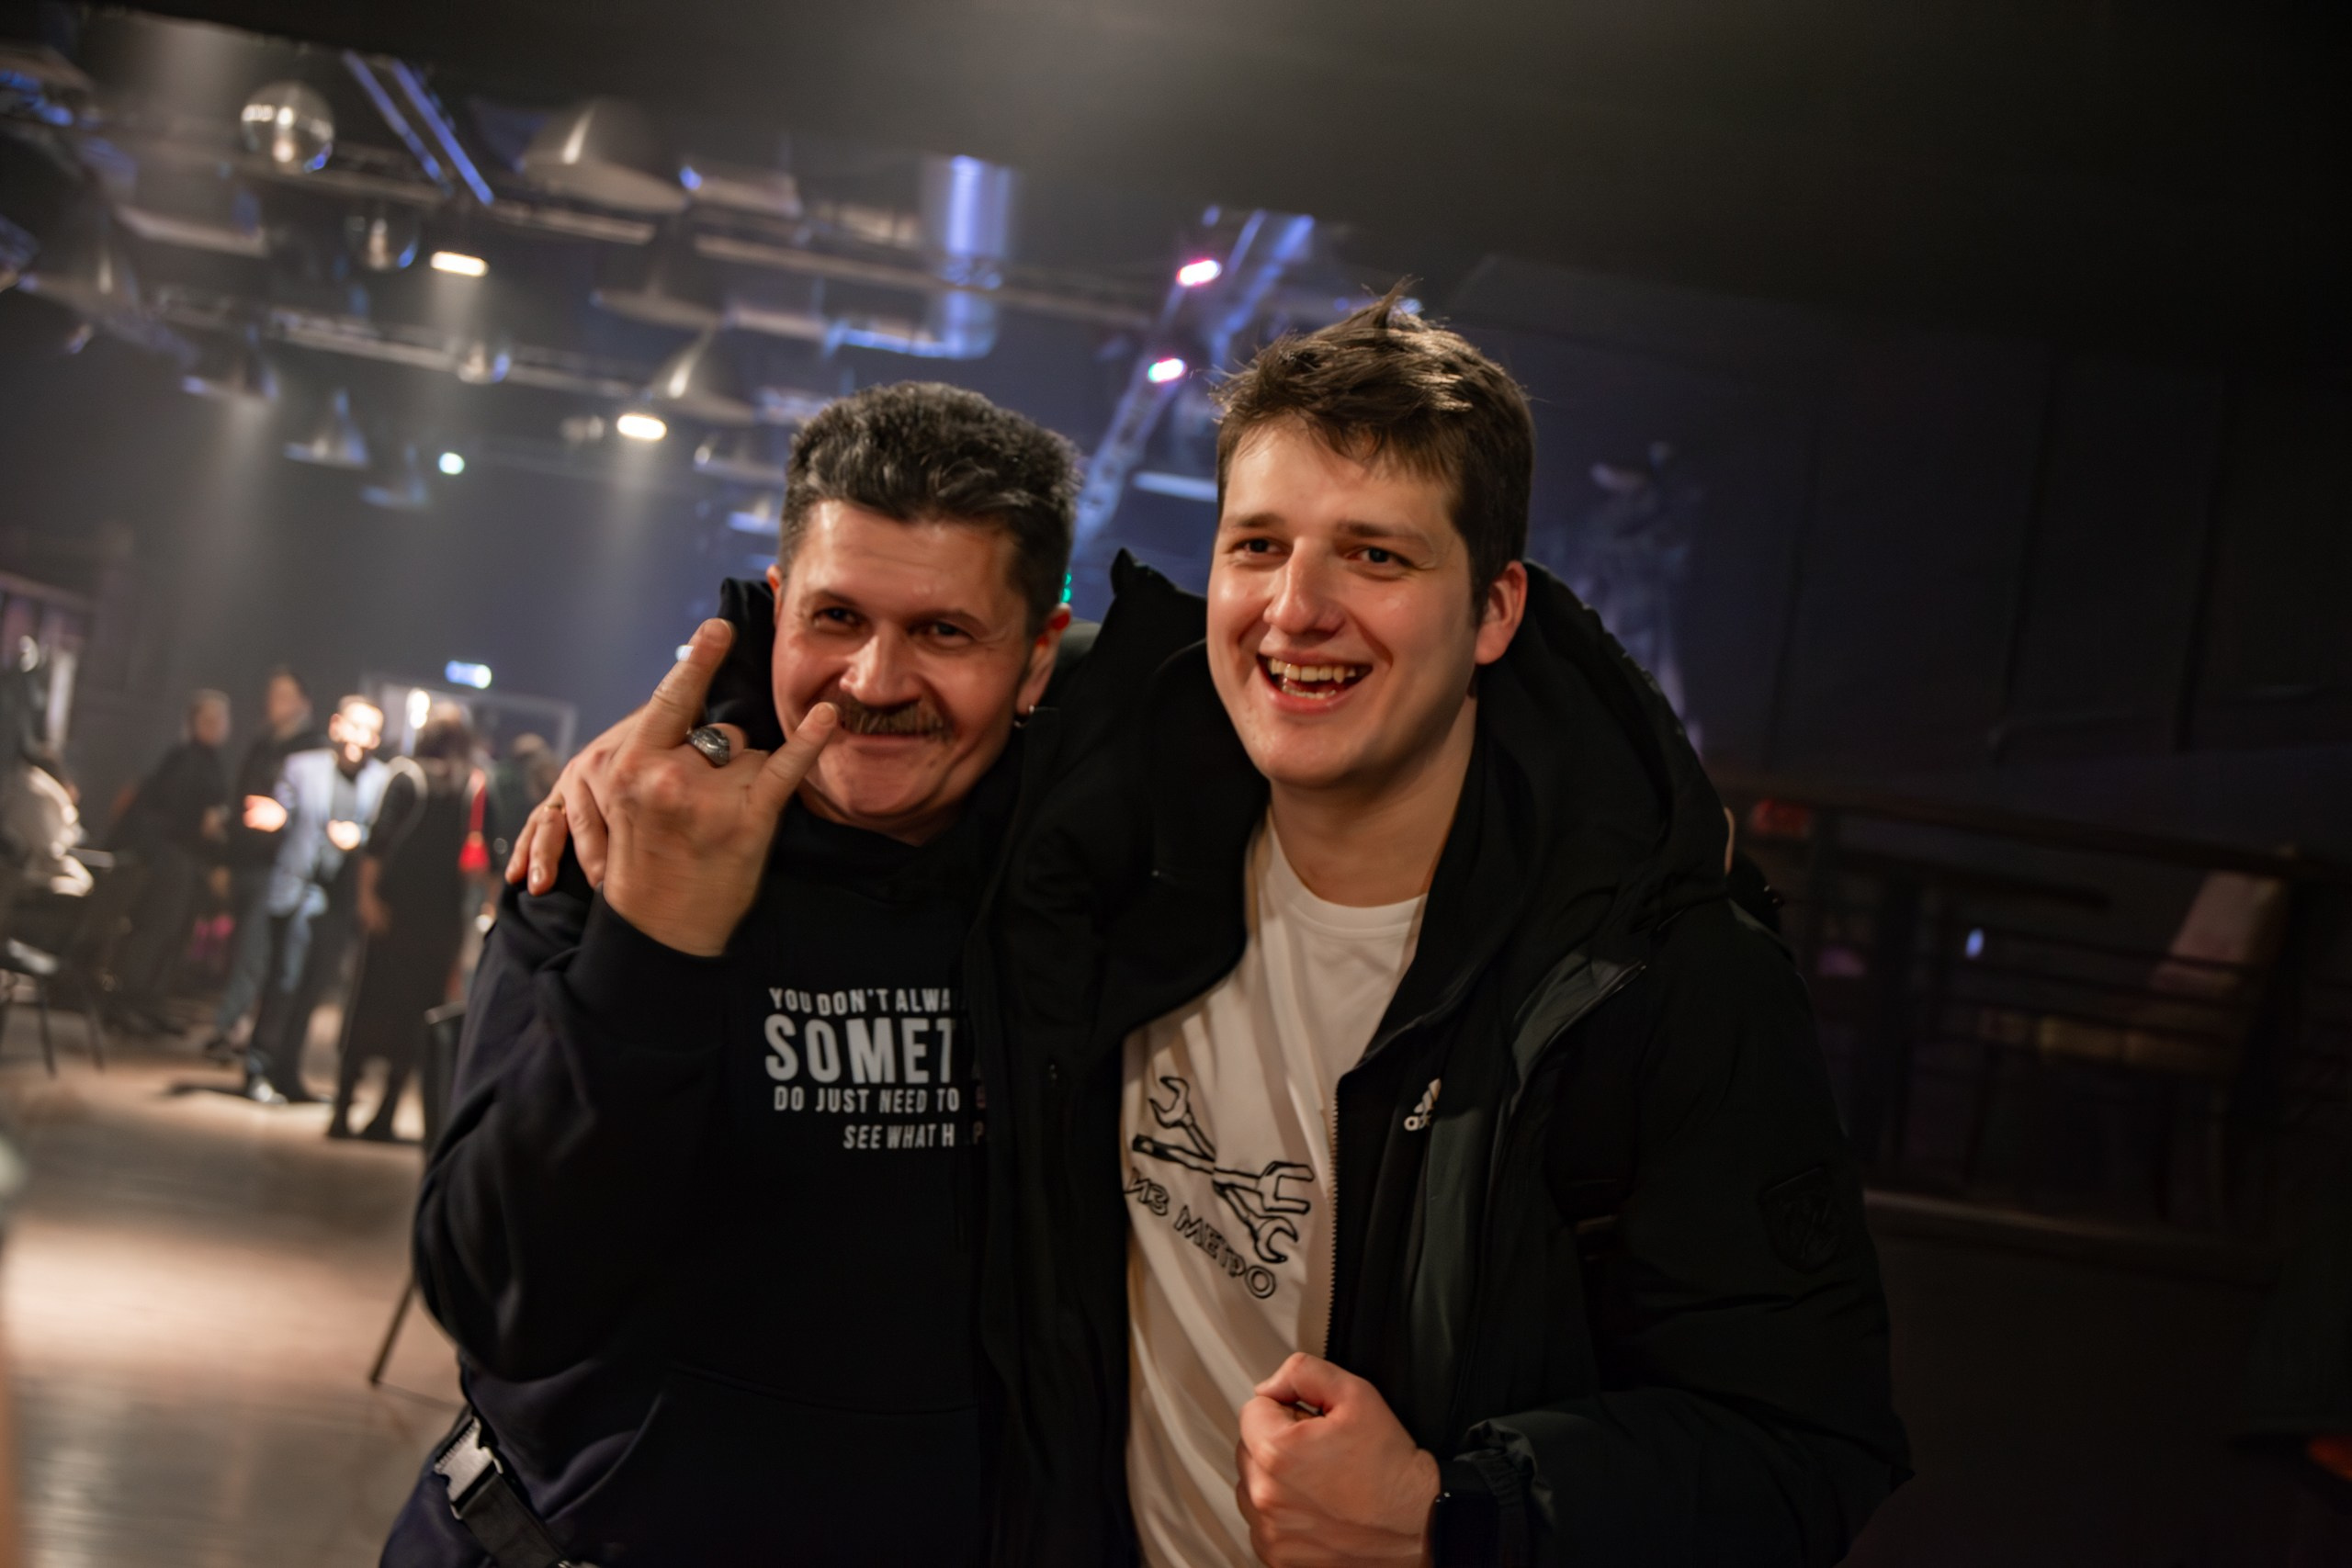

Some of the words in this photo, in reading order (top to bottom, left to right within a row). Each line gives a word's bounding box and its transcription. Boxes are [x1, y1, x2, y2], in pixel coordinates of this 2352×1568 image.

[768, 987, 812, 1014] YOU
[816, 987, 889, 1016] DON'T
[773, 1085, 805, 1112] DO
[815, 1087, 870, 1113] JUST
[878, 1088, 928, 1114] NEED
[935, 1087, 961, 1112] TO
[842, 1123, 883, 1149] SEE
[887, 1122, 937, 1149] WHAT
[1174, 1204, 1277, 1299] МЕТРО
